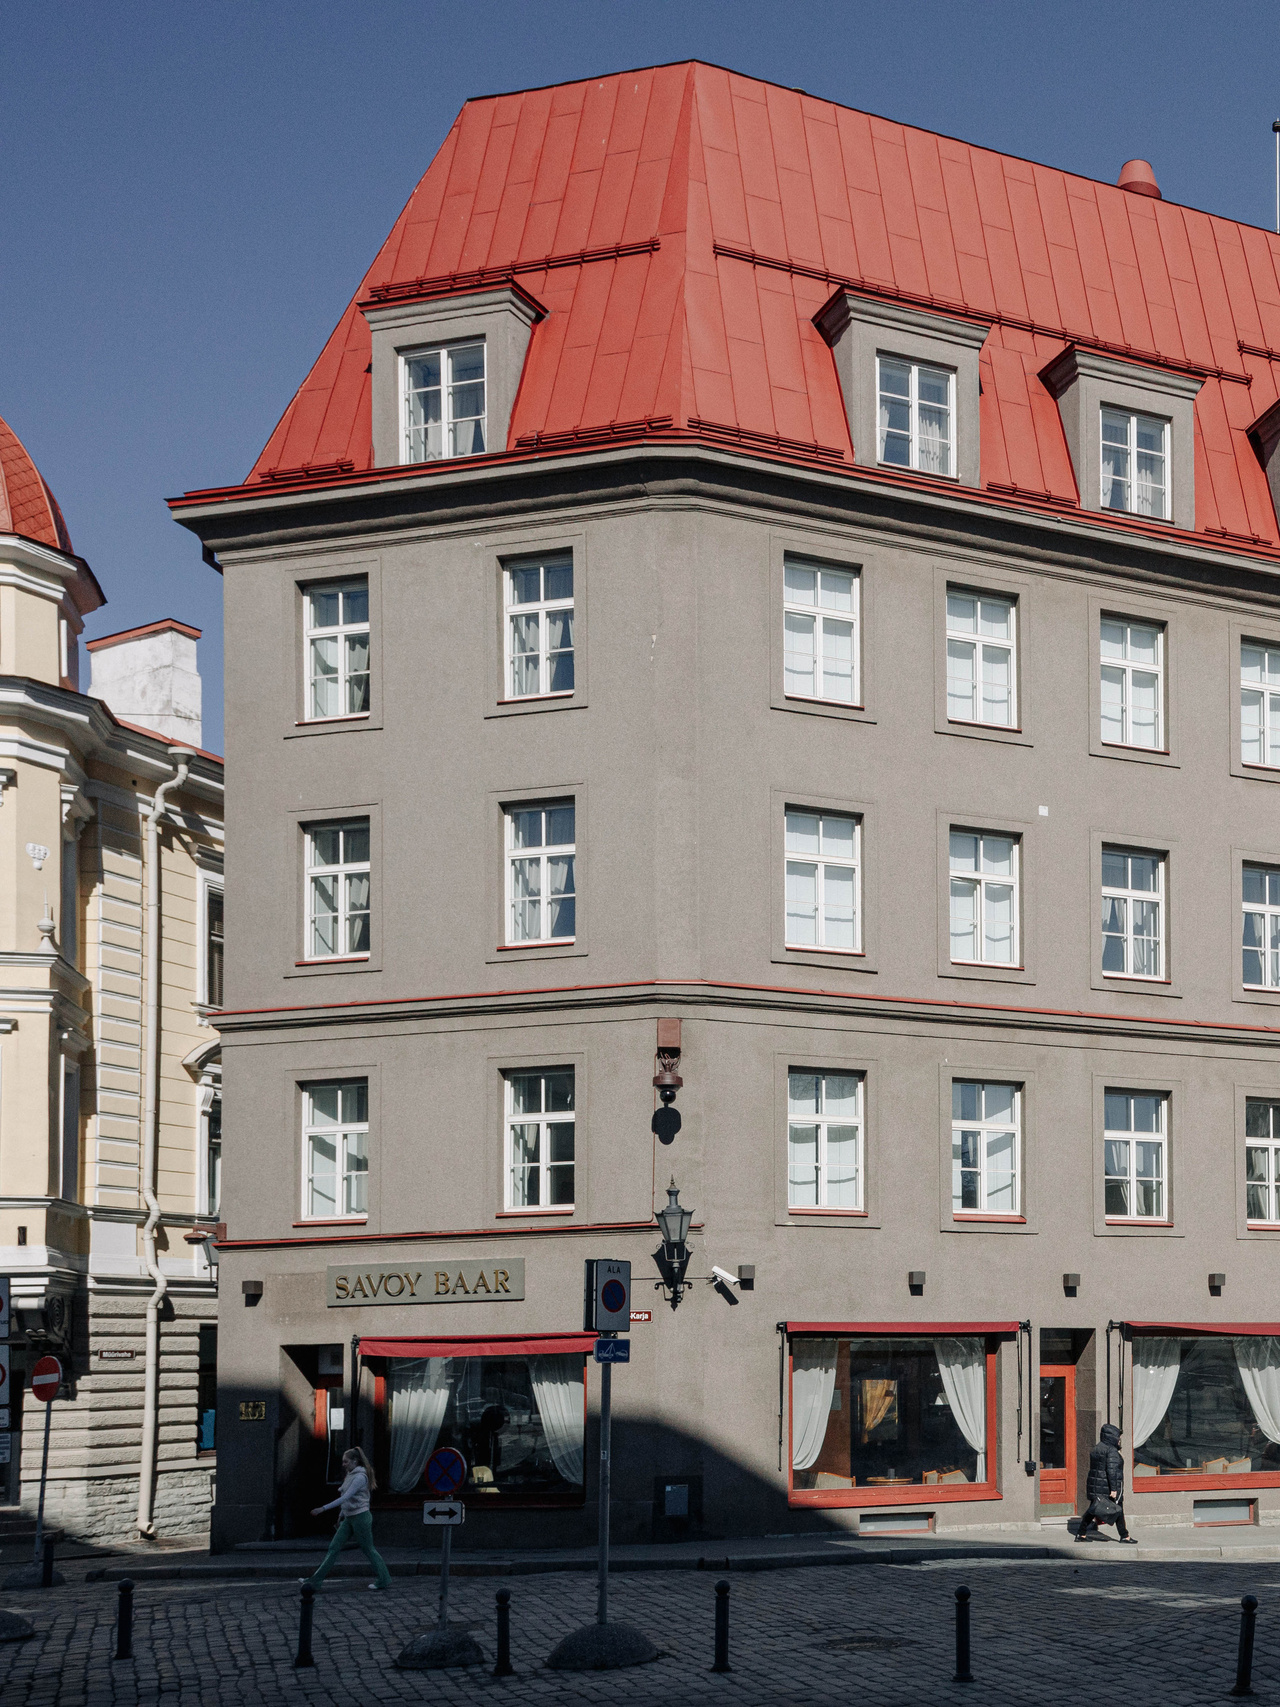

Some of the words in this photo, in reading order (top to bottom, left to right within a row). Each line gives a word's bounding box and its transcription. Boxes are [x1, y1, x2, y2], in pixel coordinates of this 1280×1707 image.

[607, 1265, 621, 1274] ALA
[335, 1272, 422, 1300] SAVOY
[434, 1269, 512, 1296] BAAR
[629, 1312, 649, 1321] -Karja
